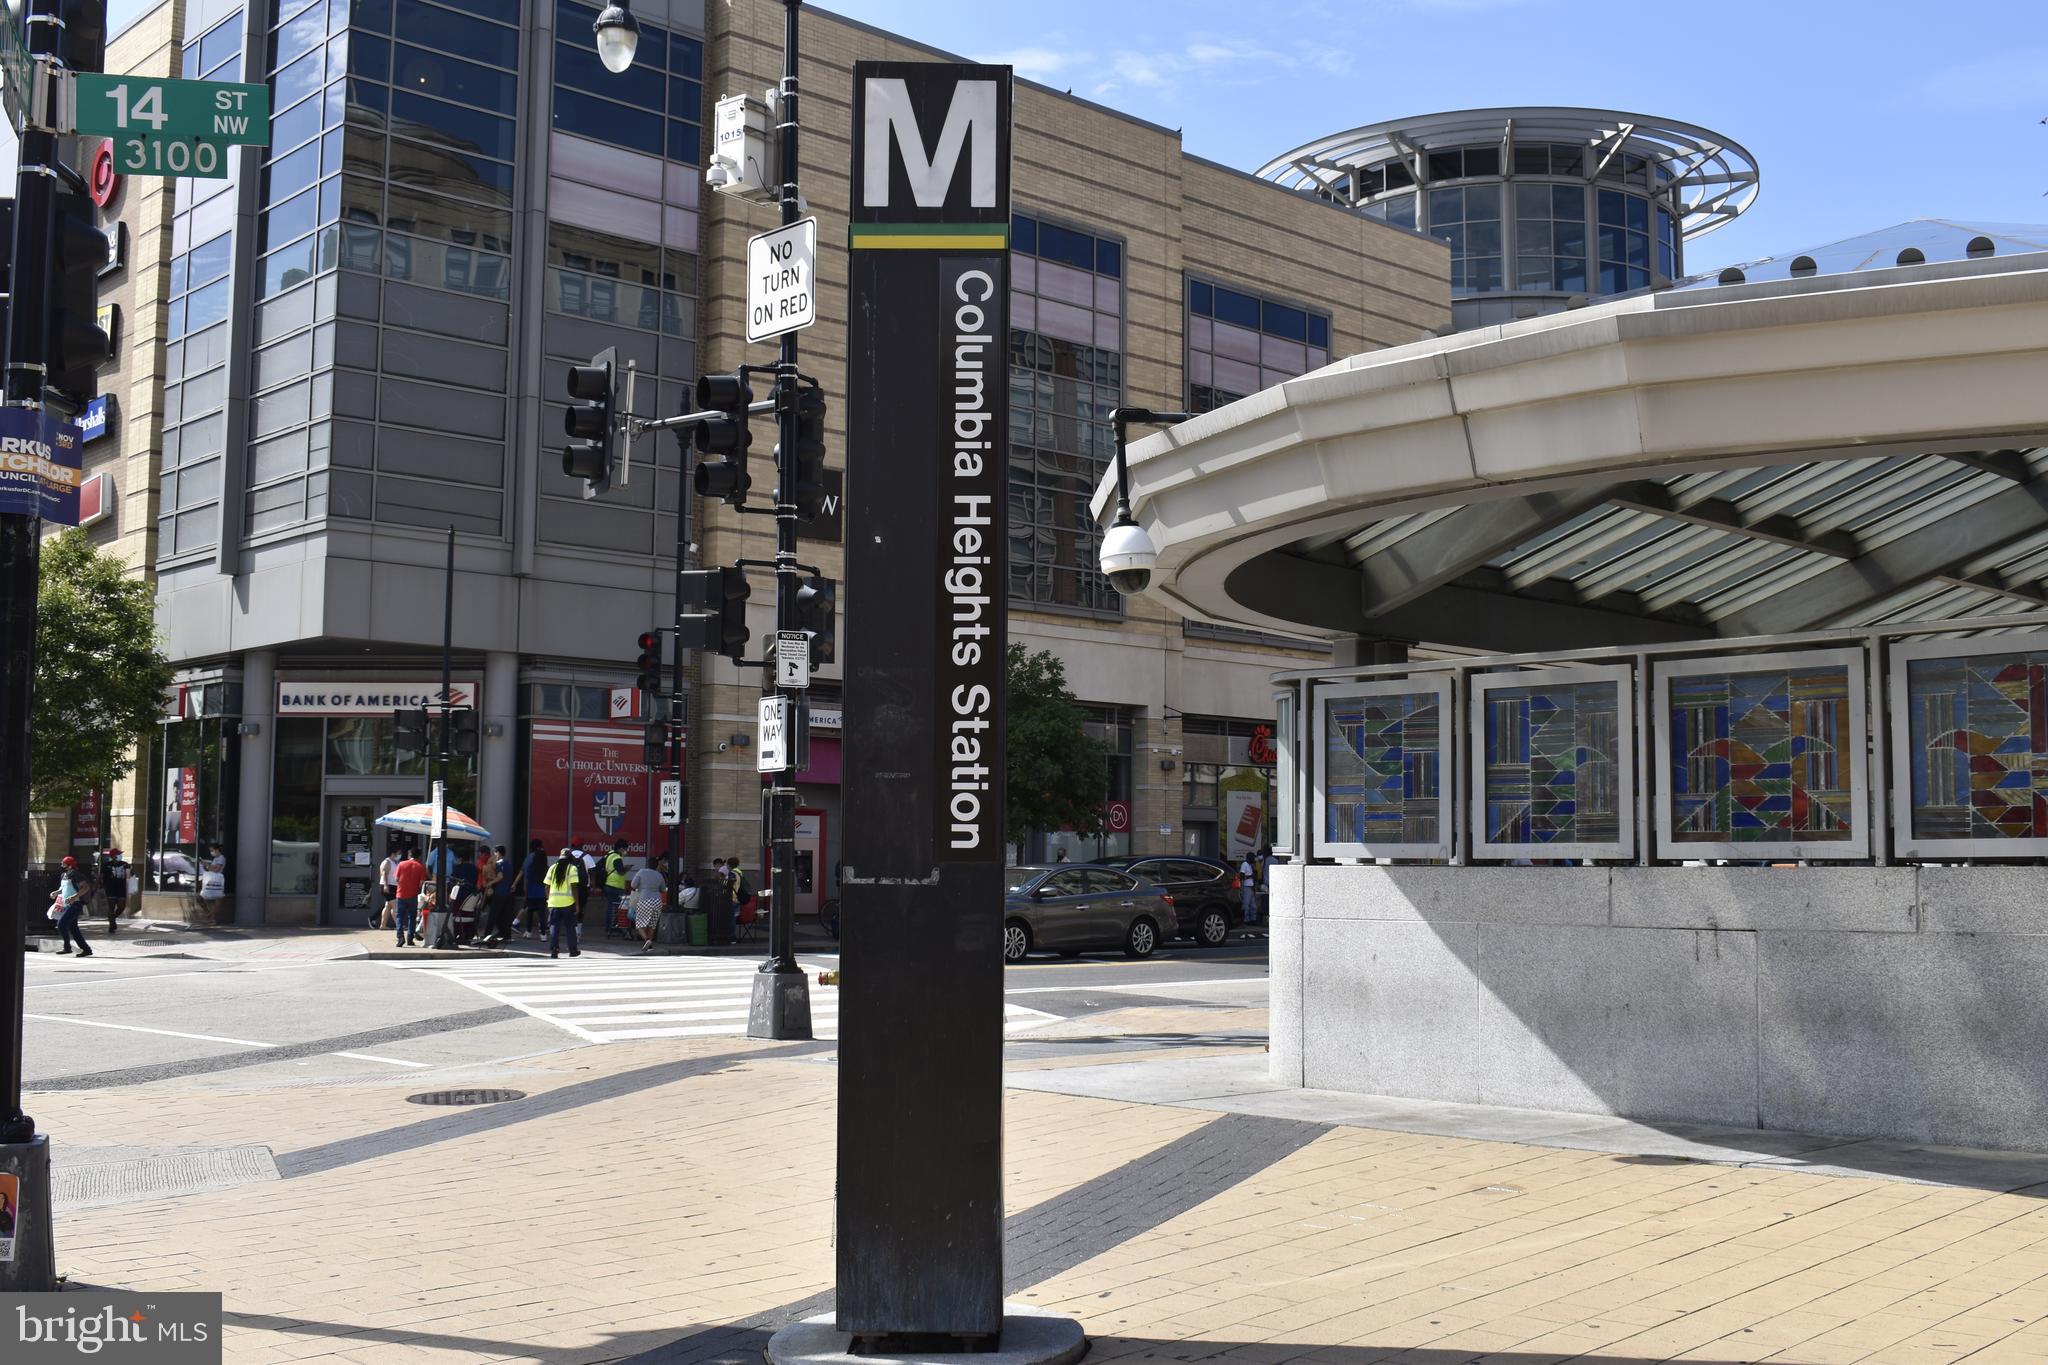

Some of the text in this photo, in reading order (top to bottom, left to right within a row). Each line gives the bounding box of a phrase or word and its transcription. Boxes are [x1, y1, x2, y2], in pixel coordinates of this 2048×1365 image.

[106, 84, 168, 130] 14
[215, 90, 248, 111] ST
[213, 115, 249, 135] NW
[720, 128, 742, 142] 1015
[864, 77, 997, 208] M
[125, 139, 217, 173] 3100
[770, 240, 792, 264] NO
[762, 265, 800, 294] TURN
[754, 293, 807, 325] ON RED
[58, 433, 74, 443] NOV
[0, 436, 51, 460] RKUS
[944, 269, 995, 849] Columbia Heights Station
[781, 632, 805, 640] NOTICE
[282, 695, 430, 706] BANK OF AMERICA
[764, 703, 782, 721] ONE
[809, 717, 837, 725] MERICA
[763, 724, 783, 742] WAY
[602, 747, 619, 758] THE
[584, 773, 637, 787] of AMERICA
[663, 785, 677, 796] ONE
[663, 798, 677, 807] WAY
